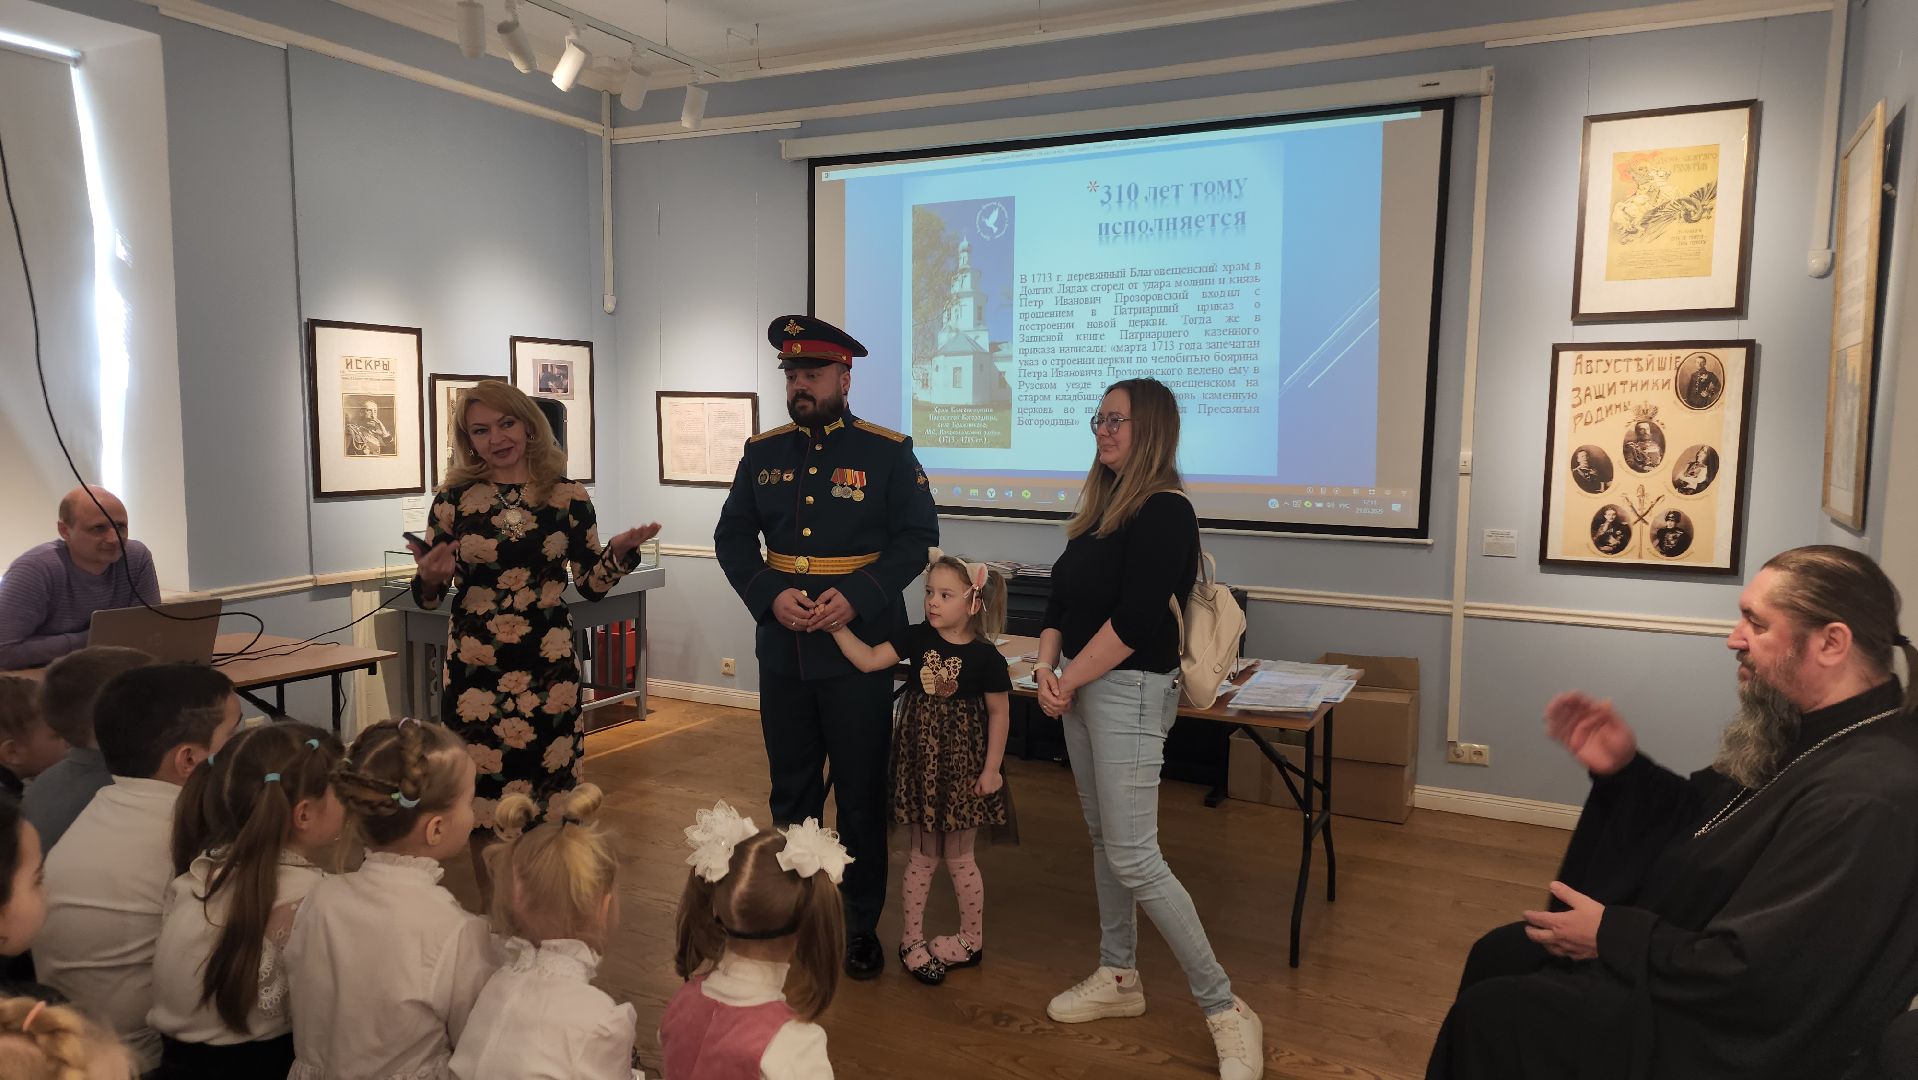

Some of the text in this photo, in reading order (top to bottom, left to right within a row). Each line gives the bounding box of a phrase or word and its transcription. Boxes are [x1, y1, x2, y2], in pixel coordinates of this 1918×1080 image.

[1100, 177, 1248, 205] 310 лет тому
[1098, 211, 1247, 236] исполняется
[1019, 274, 1028, 284] В
[1032, 272, 1053, 283] 1713
[1066, 268, 1126, 283] деревянный
[1129, 263, 1218, 278] Благовещенский
[1222, 262, 1250, 275] храм
[1019, 286, 1054, 298] Долгих
[1090, 283, 1125, 294] сгорел
[1128, 281, 1139, 290] от
[1142, 279, 1171, 291] удара
[1174, 278, 1215, 288] молнии
[1218, 277, 1226, 285] и
[1228, 275, 1261, 285] князь
[1019, 297, 1044, 309] Петр
[1055, 295, 1102, 306] Иванович
[1114, 290, 1189, 305] Прозоровский
[1201, 289, 1241, 299] входил
[1019, 309, 1074, 321] прошением
[1113, 303, 1179, 317] Патриарший
[1197, 302, 1235, 314] приказ
[1019, 321, 1075, 332] построении
[1086, 318, 1117, 329] новой
[1182, 315, 1213, 326] Тогда
[1225, 315, 1240, 323] же
[1019, 327, 1260, 343] Записной книге Патриаршего казенного
[1018, 346, 1056, 357] приказа
[1151, 341, 1175, 351] 1713
[1178, 341, 1203, 351] года
[1205, 339, 1260, 350] запечатан
[345, 358, 390, 371] ИСКРЫ
[1019, 358, 1039, 368] указ
[1050, 357, 1095, 368] строении
[1097, 356, 1133, 367] церкви
[1136, 356, 1148, 364] по
[1151, 353, 1210, 364] челобитью
[1213, 352, 1259, 364] боярина
[1018, 368, 1048, 381] Петра
[1051, 367, 1103, 378] Ивановича
[1107, 366, 1183, 379] Прозоровского
[1187, 366, 1224, 375] велено
[1228, 366, 1250, 376] ему
[1018, 380, 1057, 392] Рузском
[1065, 381, 1092, 391] уезде
[1246, 379, 1259, 387] на
[1571, 378, 1671, 408] ЗАЩИТНИКИ
[1017, 393, 1051, 404] старом
[1202, 391, 1258, 402] каменную
[1017, 406, 1054, 417] церковь
[1063, 406, 1075, 414] во
[1198, 403, 1260, 416] Пресвятыя
[1572, 401, 1631, 433] РОДИНЫ
